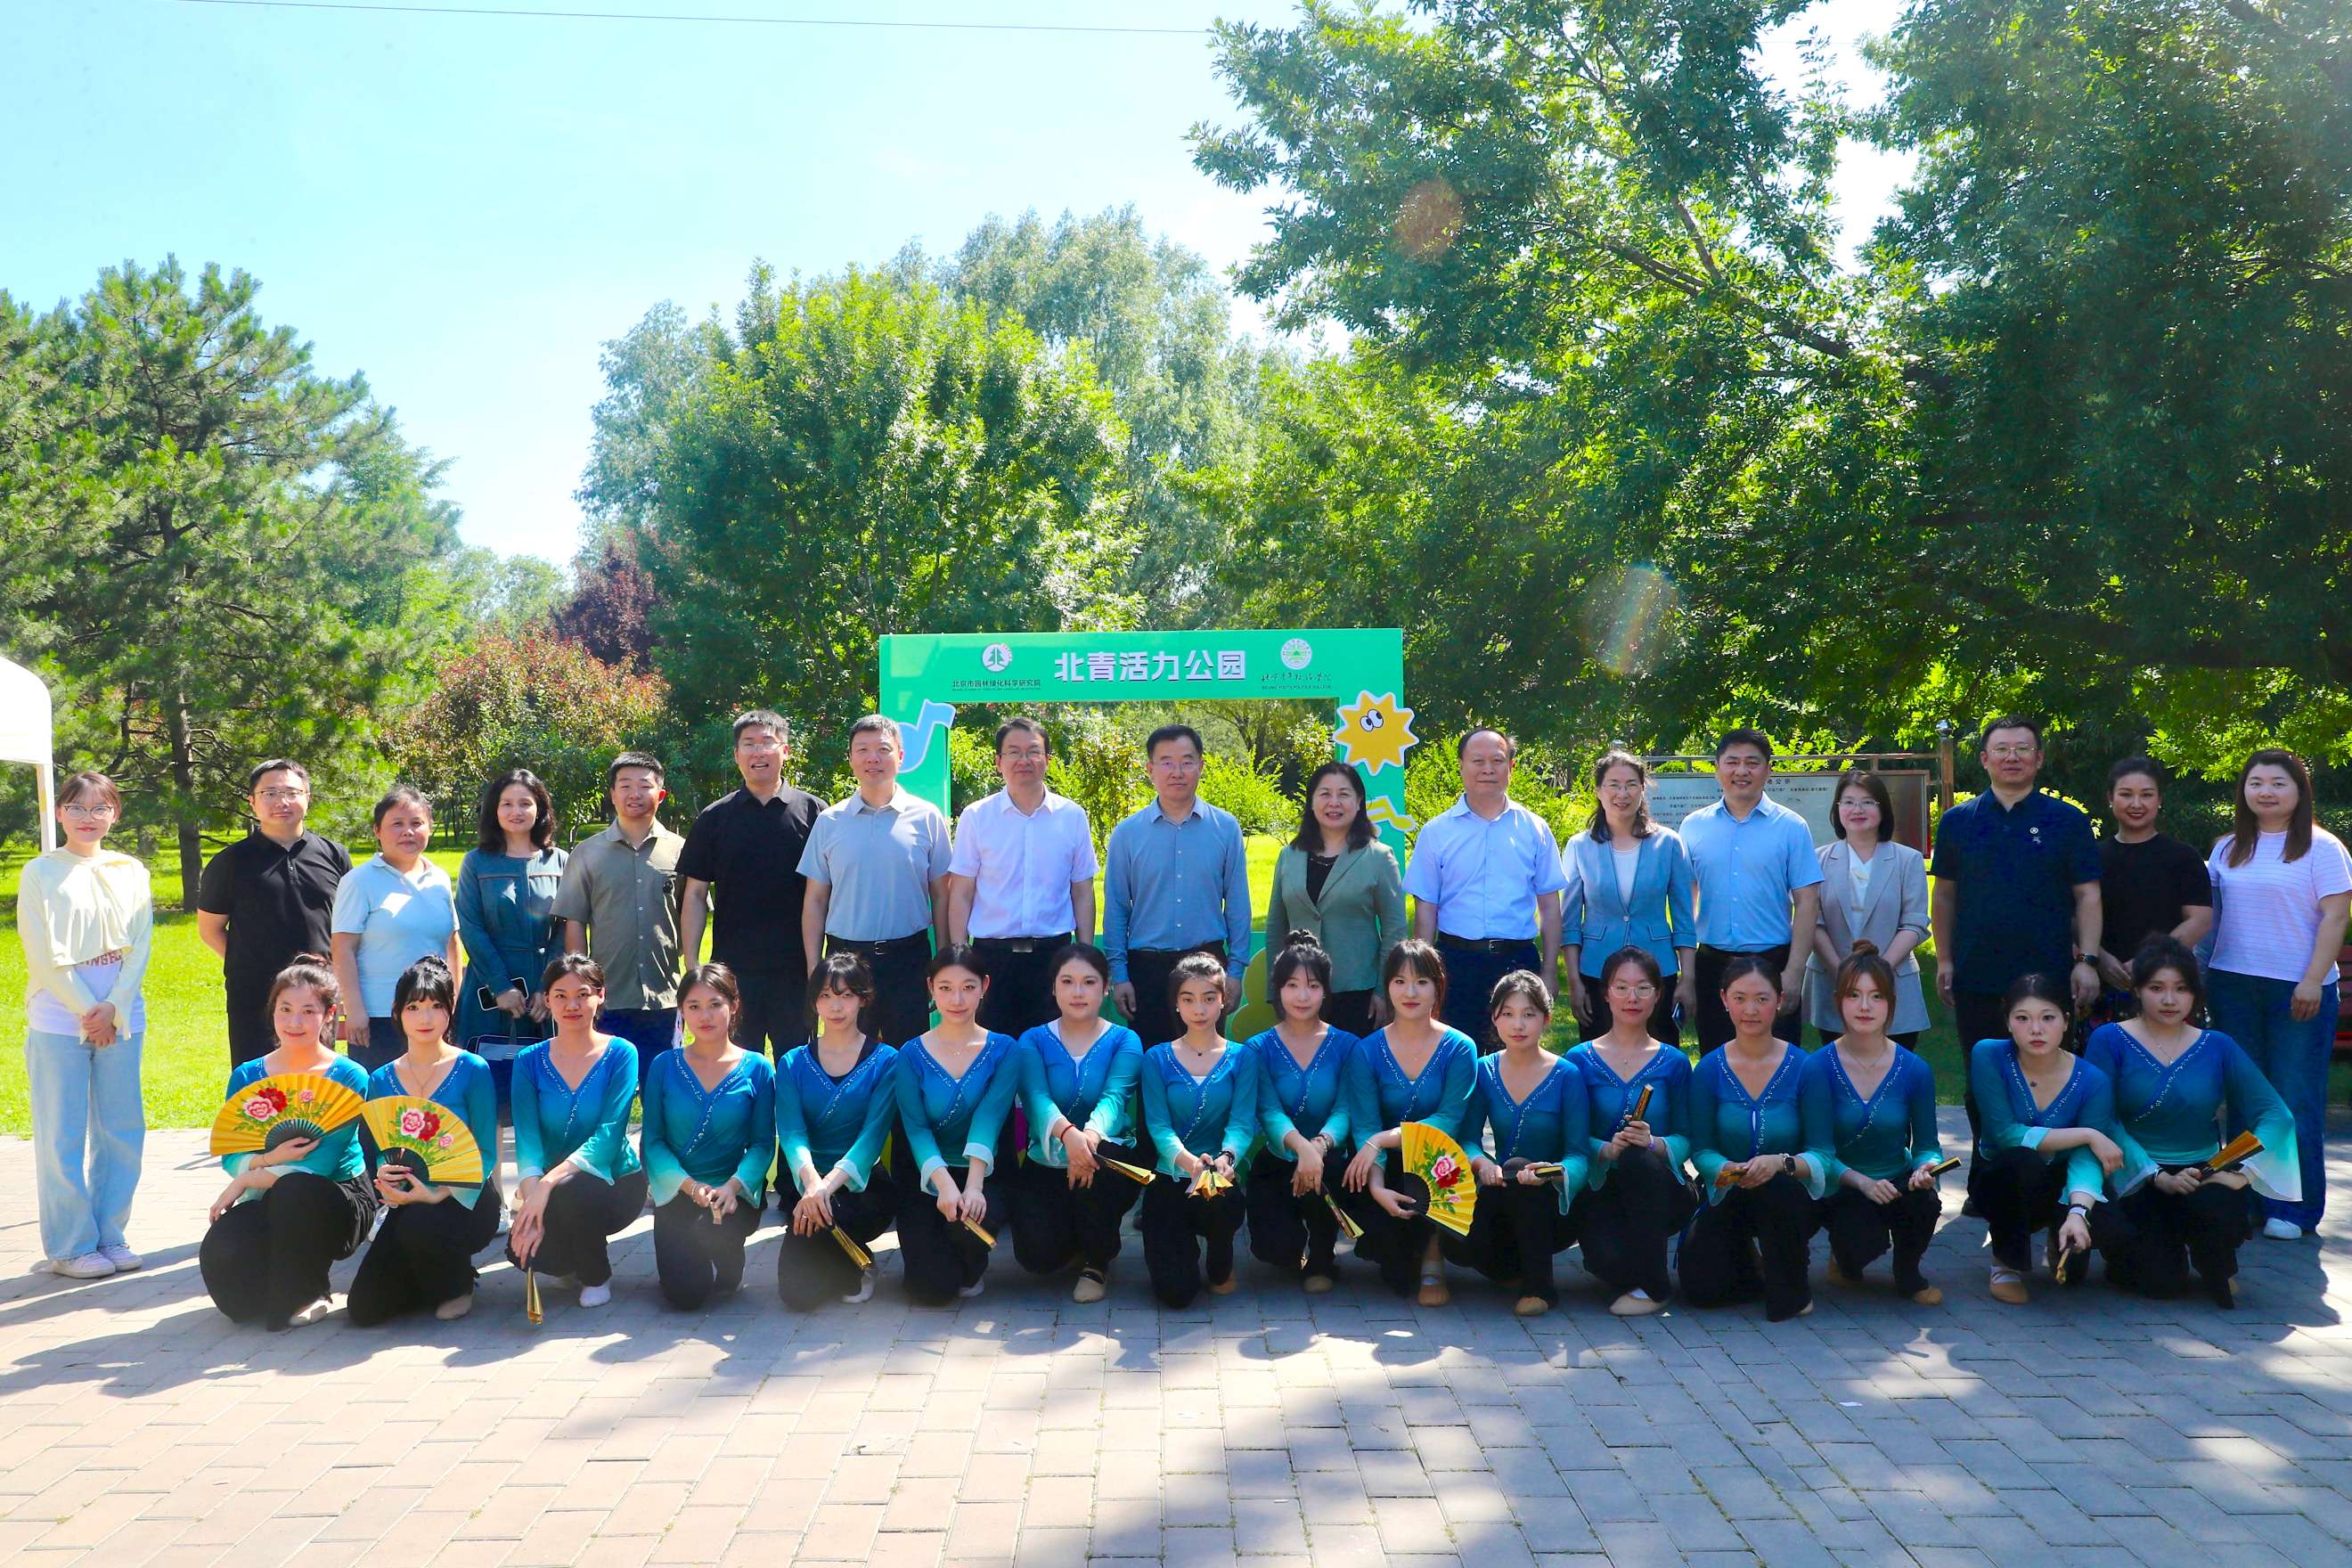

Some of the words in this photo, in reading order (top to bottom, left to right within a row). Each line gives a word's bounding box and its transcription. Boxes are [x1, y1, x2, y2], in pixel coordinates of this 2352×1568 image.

[1055, 649, 1246, 682] 北青活力公园
